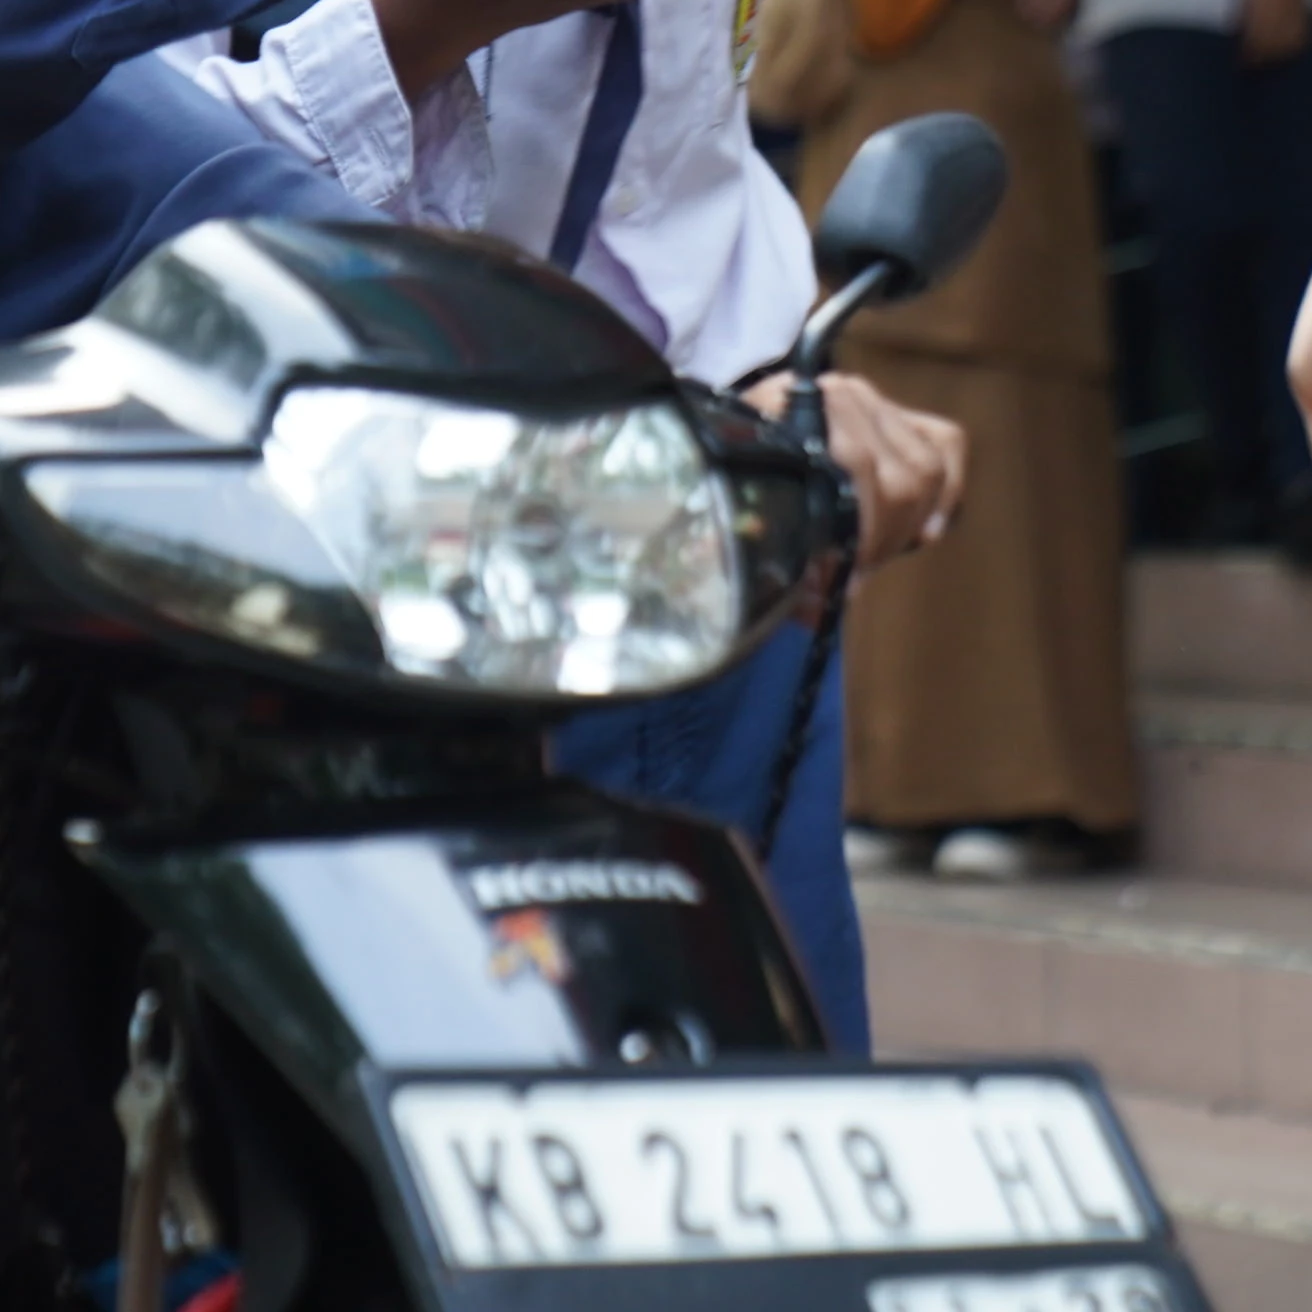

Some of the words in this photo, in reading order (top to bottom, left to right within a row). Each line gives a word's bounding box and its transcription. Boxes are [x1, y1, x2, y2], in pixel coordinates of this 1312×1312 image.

[473, 859, 703, 909] HONDA
[448, 1132, 605, 1252] KB
[640, 1127, 910, 1241] 2418
[971, 1126, 1121, 1240] HL
